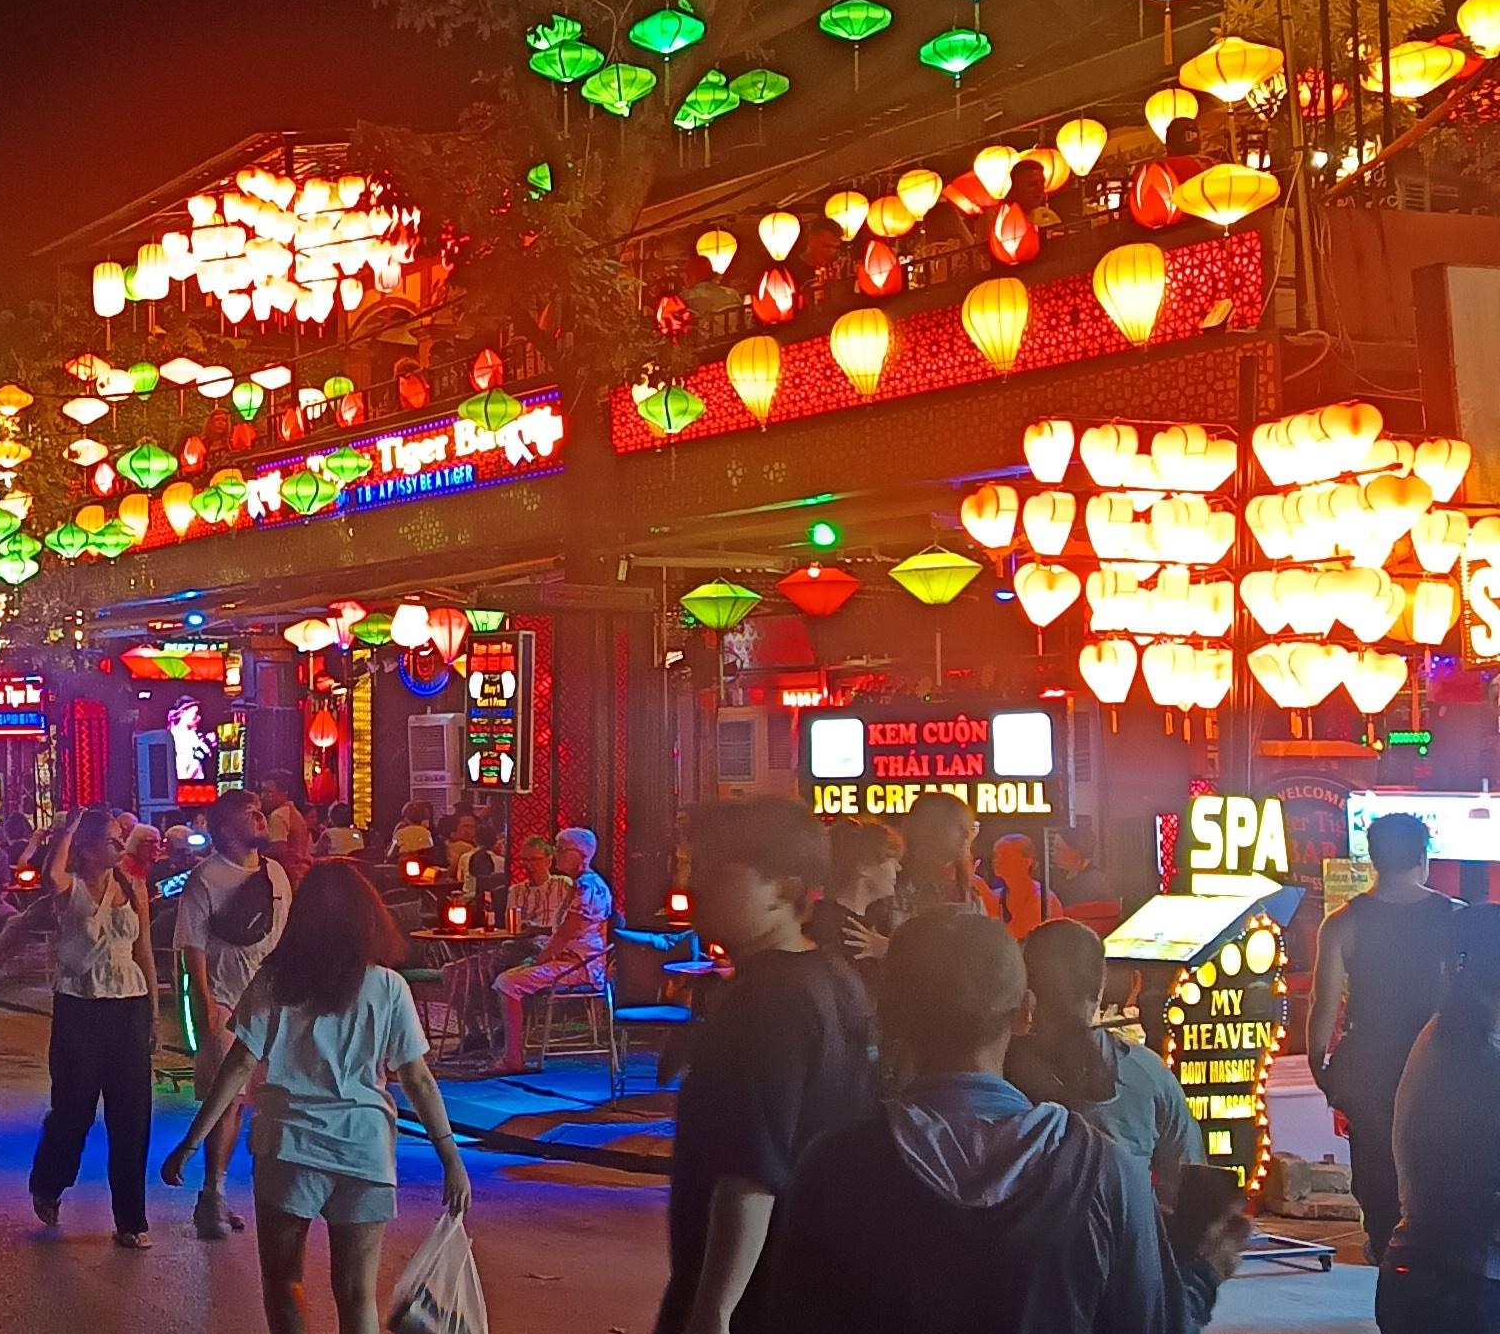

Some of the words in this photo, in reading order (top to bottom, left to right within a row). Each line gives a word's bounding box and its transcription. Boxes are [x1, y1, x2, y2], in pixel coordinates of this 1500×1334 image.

[377, 435, 449, 474] Tiger
[419, 472, 433, 491] BE
[435, 470, 443, 488] A
[868, 723, 917, 746] KEM
[923, 714, 989, 748] CUỘN
[873, 749, 930, 777] THÁI
[936, 753, 983, 776] LAN
[814, 785, 859, 814] ICE
[866, 783, 969, 814] CREM
[976, 782, 1052, 813] ROLL
[1277, 785, 1347, 811] WELCOME
[1190, 795, 1289, 873] SPA
[1210, 989, 1244, 1017] MY
[1183, 1022, 1272, 1051] HEAVEN
[1180, 1060, 1207, 1085] BODY
[1209, 1059, 1256, 1084] MASSAGE
[1210, 1094, 1257, 1120] MASSAGE
